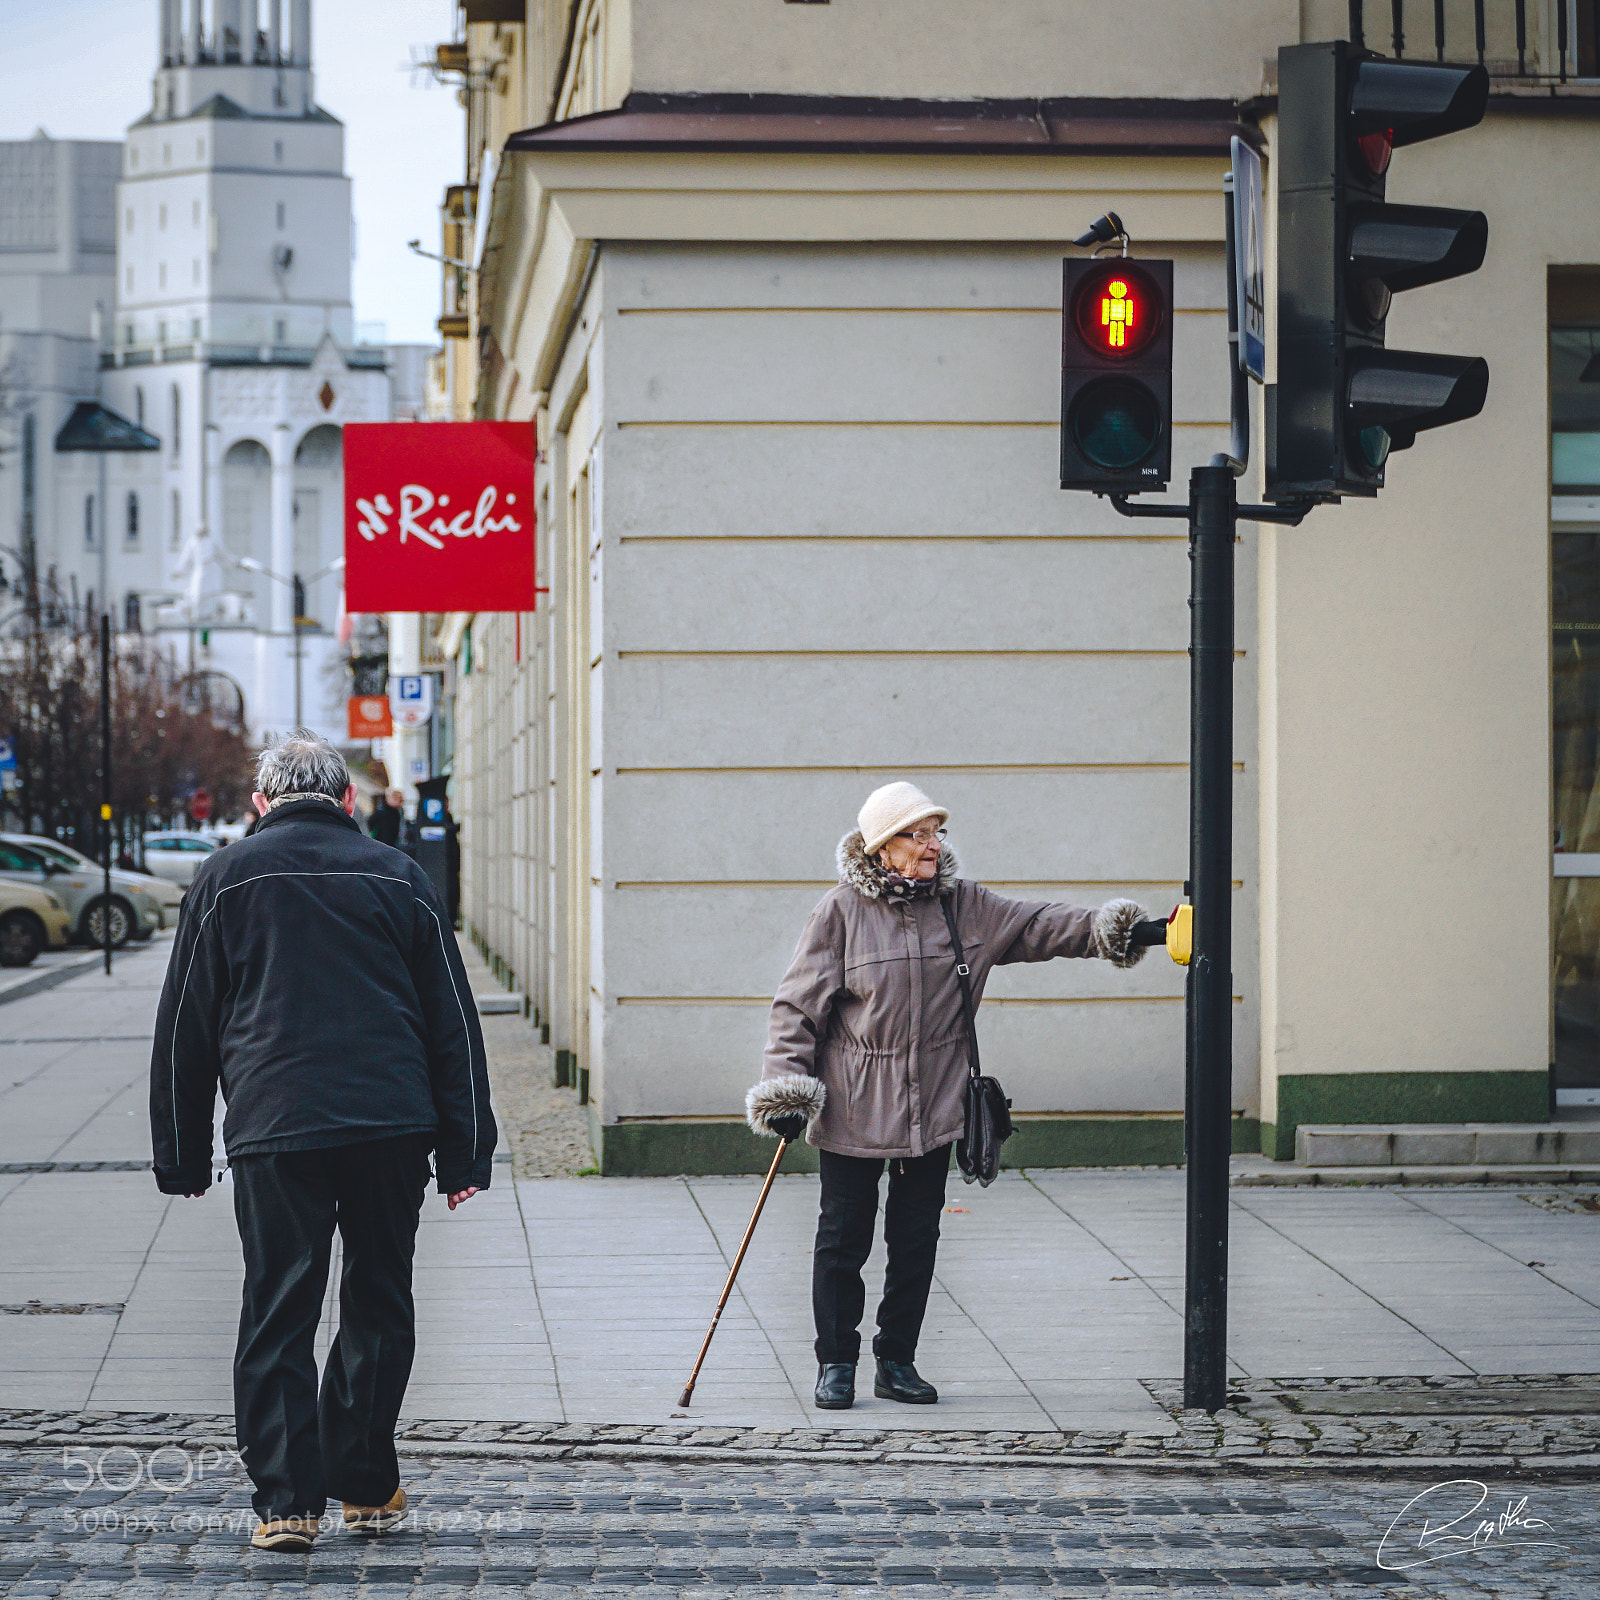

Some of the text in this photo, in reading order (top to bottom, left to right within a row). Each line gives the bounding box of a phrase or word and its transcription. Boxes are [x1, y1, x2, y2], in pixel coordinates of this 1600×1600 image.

[398, 483, 521, 550] Richi
[403, 676, 419, 698] P
[426, 798, 442, 819] P
